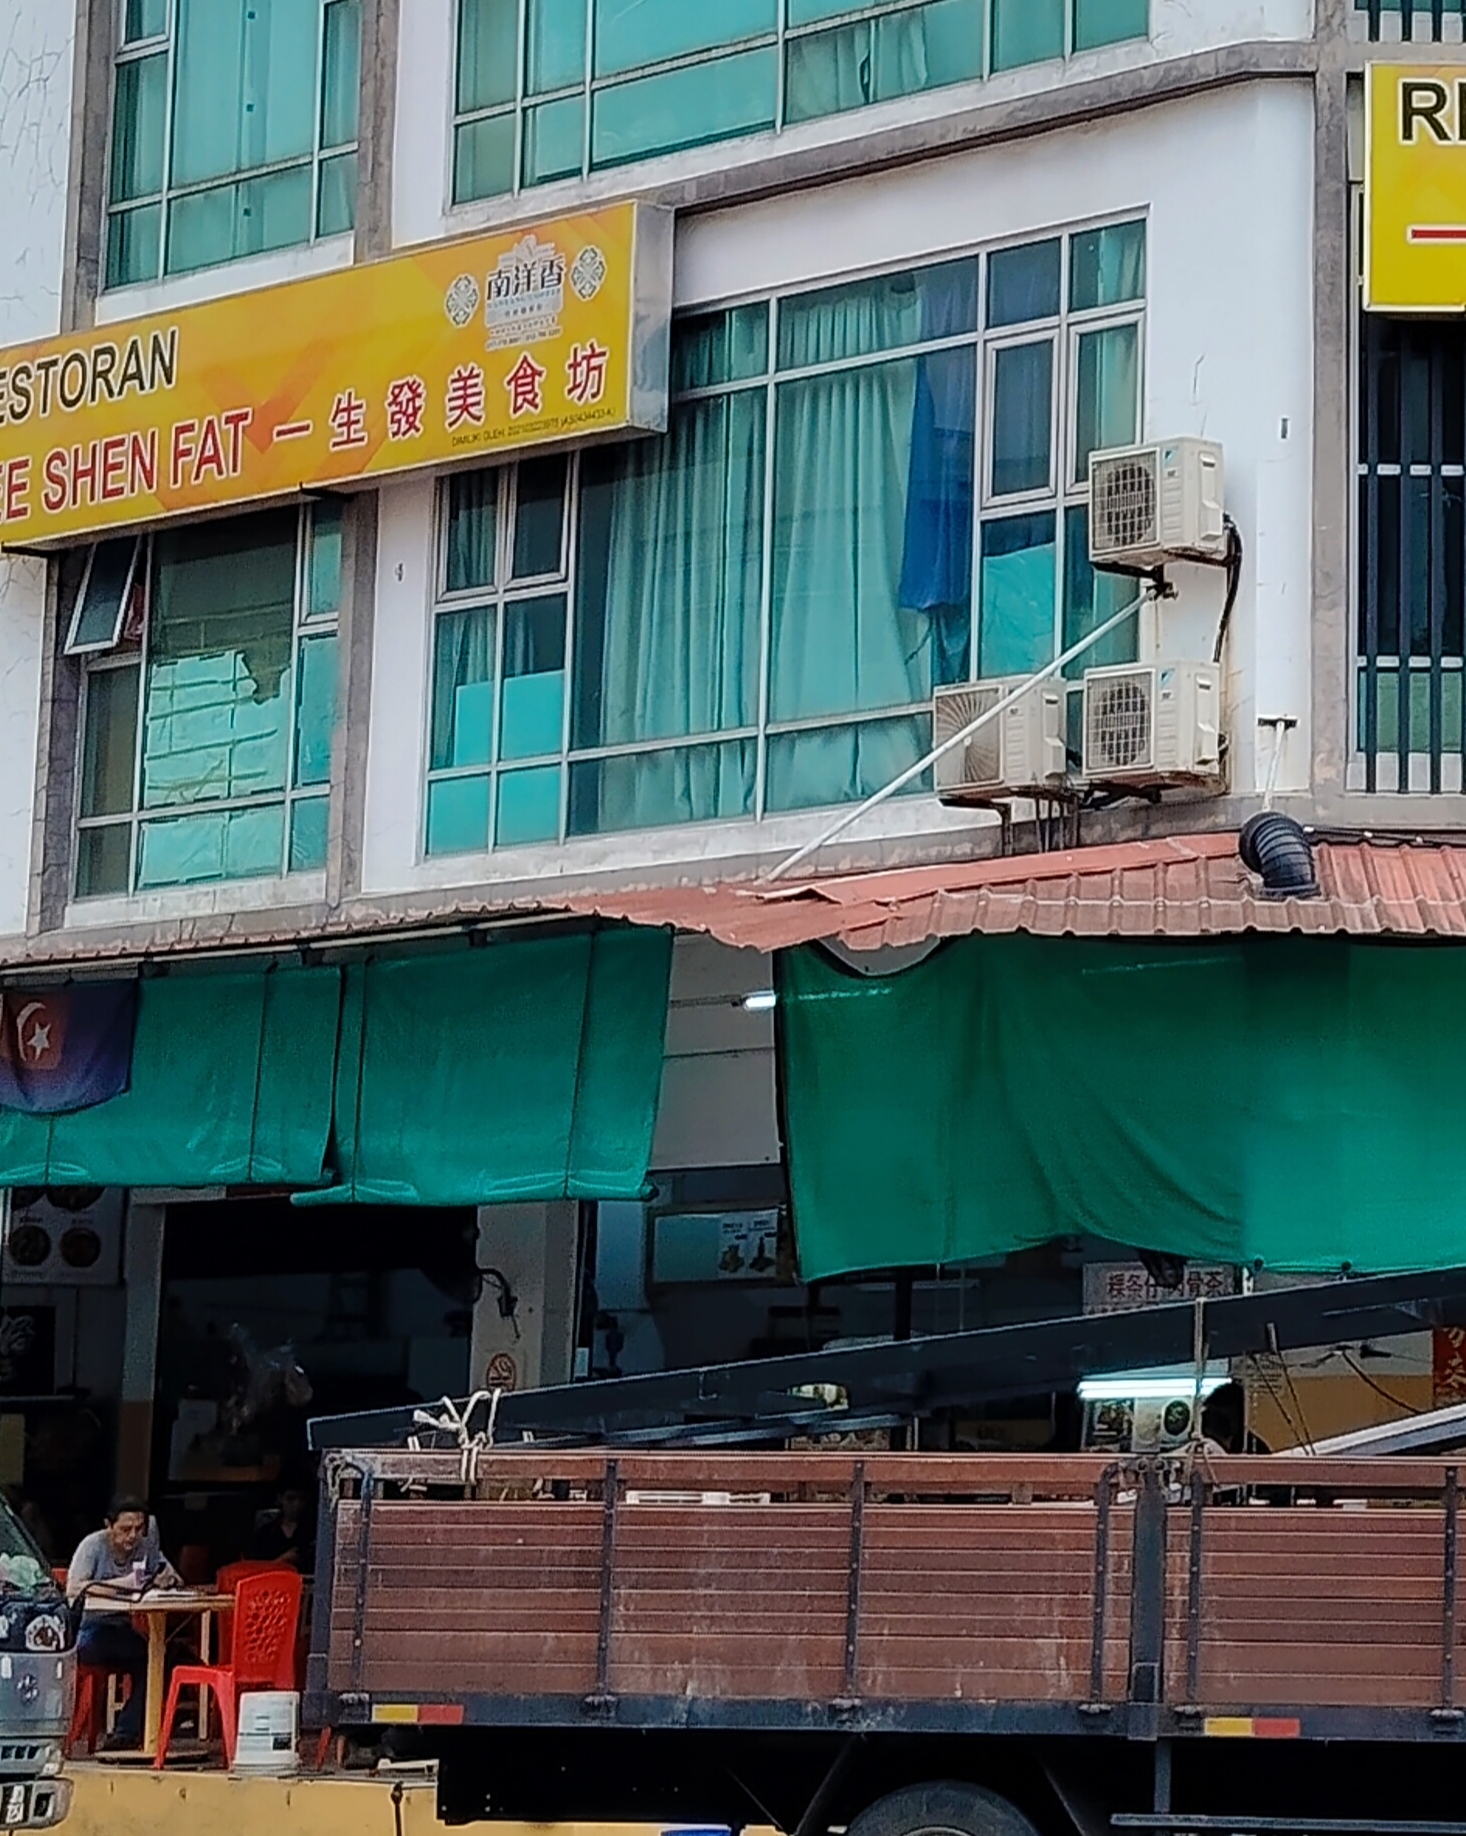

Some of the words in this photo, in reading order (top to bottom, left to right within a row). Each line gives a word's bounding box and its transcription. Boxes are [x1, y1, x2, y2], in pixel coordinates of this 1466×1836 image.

[486, 258, 565, 301] 南洋香
[44, 430, 157, 511] SHEN
[172, 411, 250, 486] FAT
[273, 340, 608, 449] 一生發美食坊
